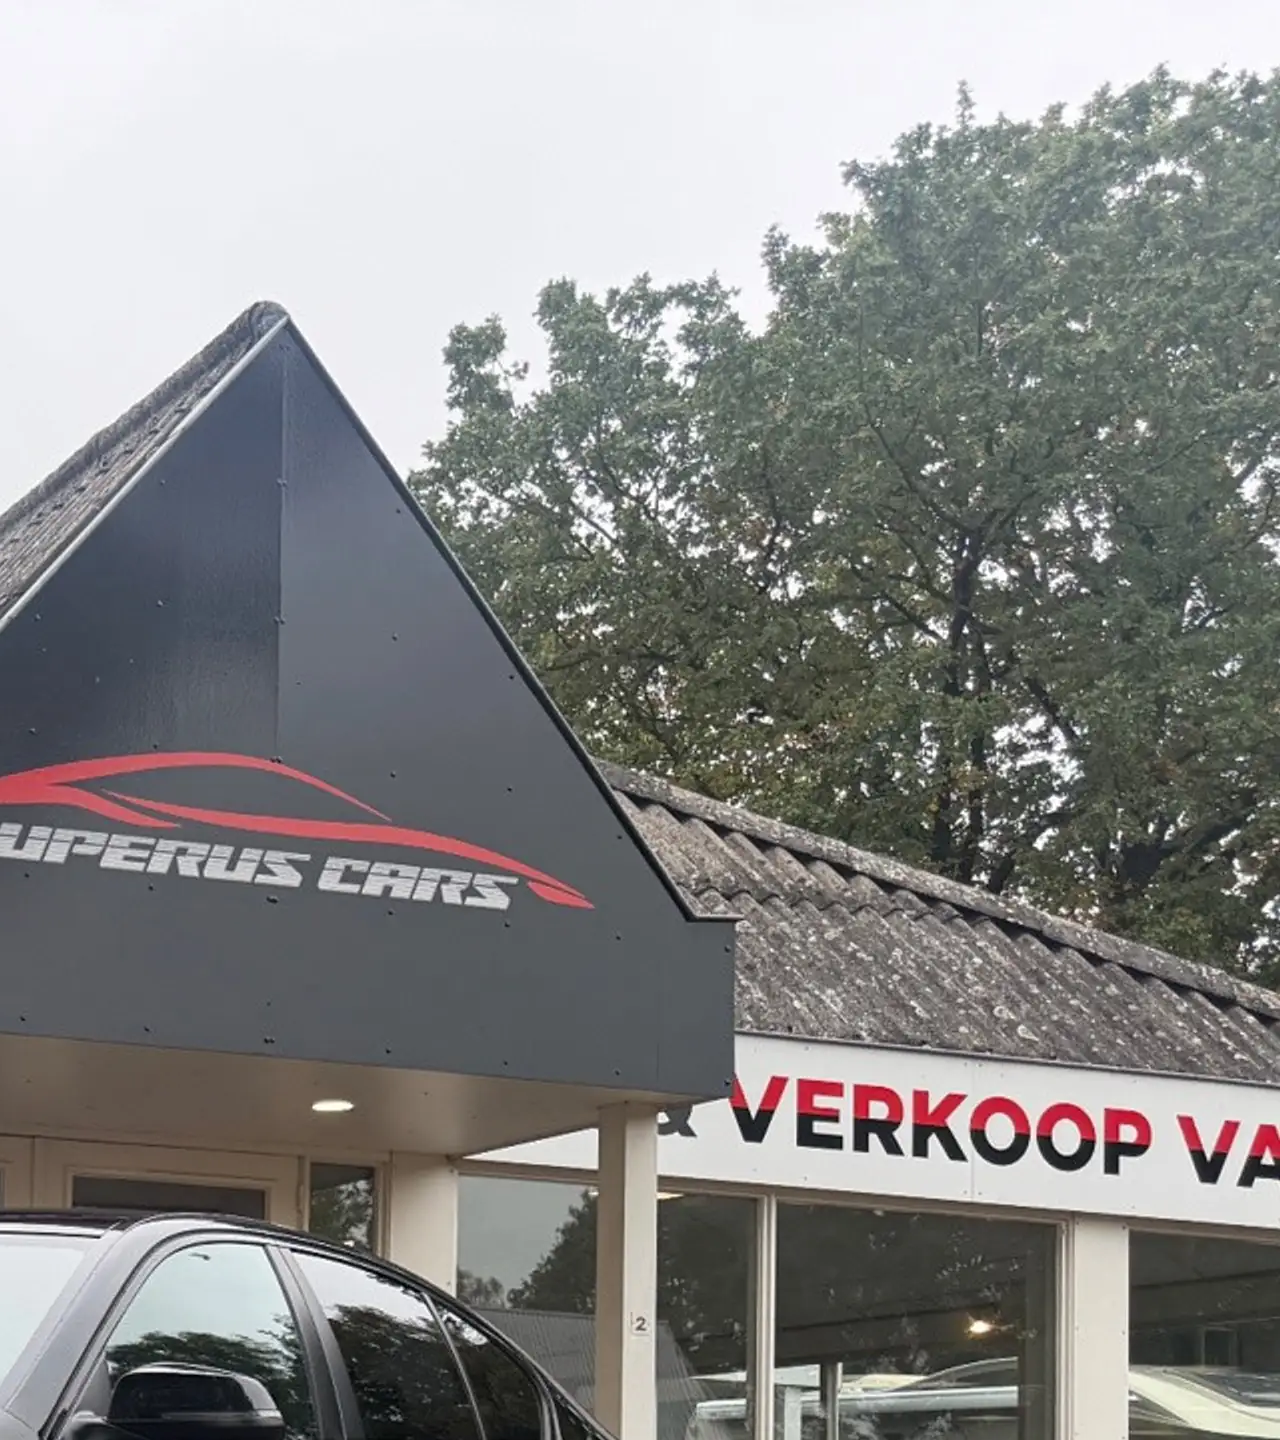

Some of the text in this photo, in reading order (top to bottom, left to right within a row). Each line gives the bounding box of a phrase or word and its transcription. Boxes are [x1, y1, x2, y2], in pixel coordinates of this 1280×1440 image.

[317, 856, 520, 911] CARS
[729, 1073, 1153, 1176] VERKOOP
[635, 1315, 647, 1331] 2
